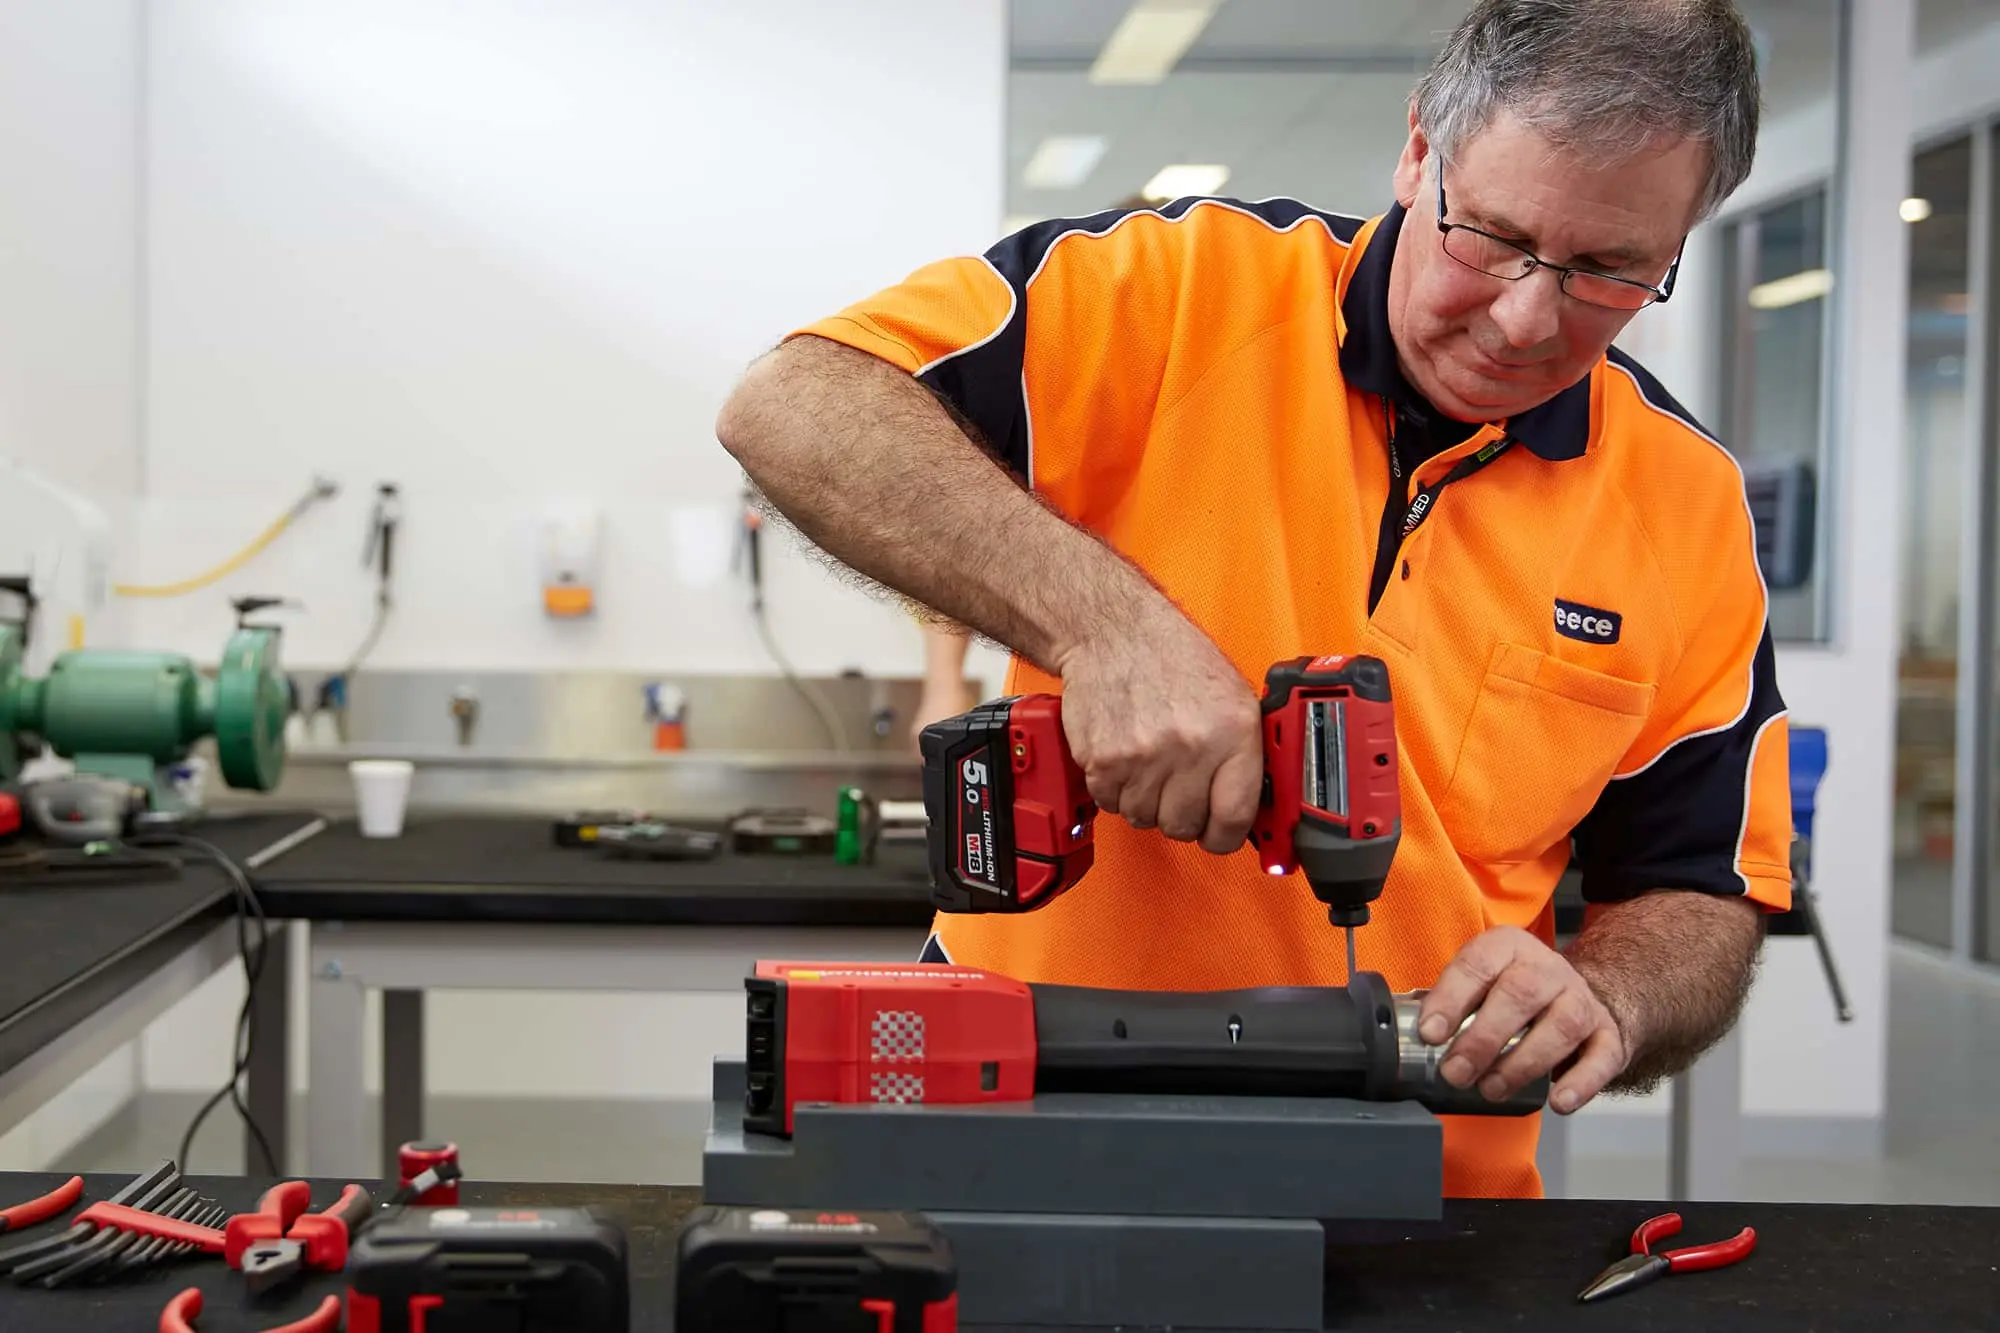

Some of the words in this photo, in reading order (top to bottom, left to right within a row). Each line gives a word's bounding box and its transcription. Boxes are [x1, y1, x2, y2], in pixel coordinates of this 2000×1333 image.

[1555, 606, 1613, 637] eece
[963, 760, 987, 803] 5.0
[968, 835, 981, 873] M18
